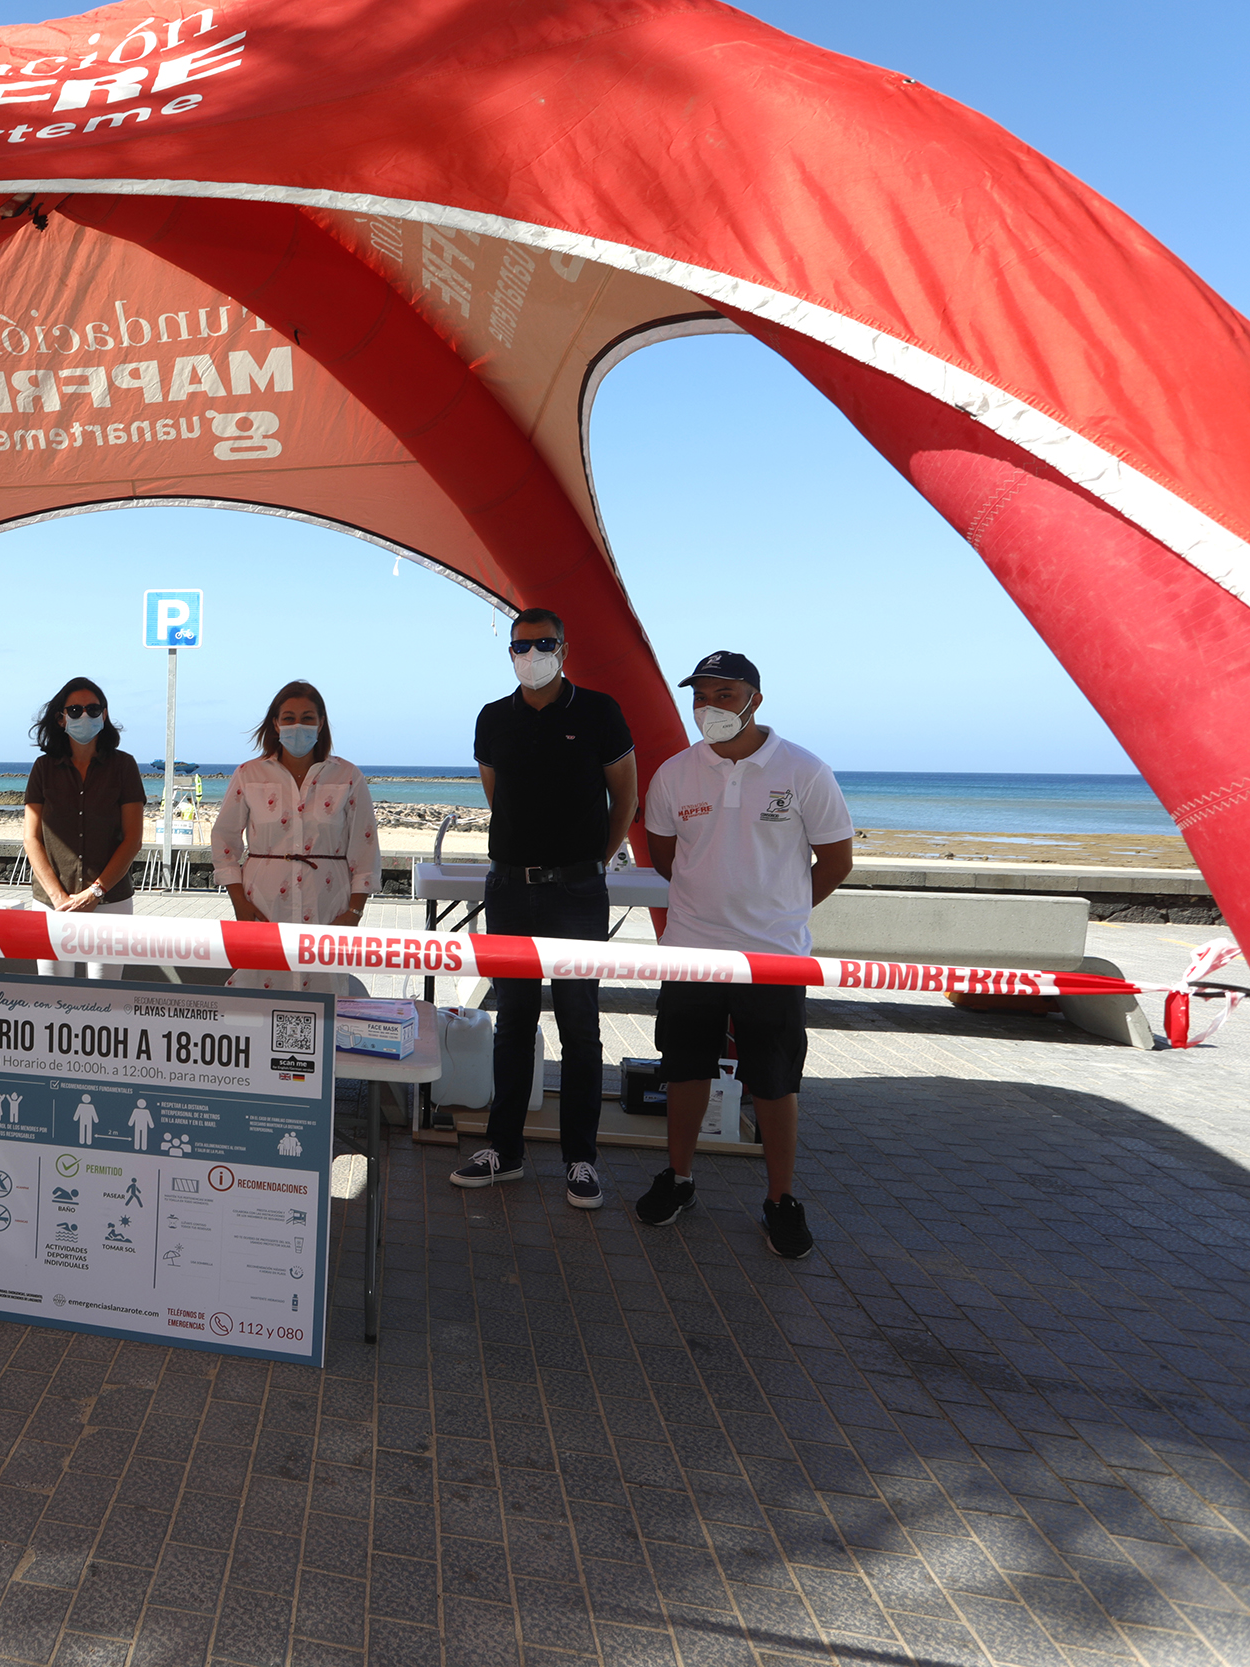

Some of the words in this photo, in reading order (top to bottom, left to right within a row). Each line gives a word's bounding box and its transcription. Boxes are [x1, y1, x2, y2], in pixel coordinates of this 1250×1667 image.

[157, 599, 190, 640] P
[678, 805, 713, 817] MAPFRE
[298, 933, 462, 972] BOMBEROS
[33, 1000, 51, 1009] con
[55, 999, 112, 1014] Seguridad
[134, 996, 185, 1007] RECOMENDACIONES
[186, 1000, 218, 1009] GENERALES
[134, 1005, 165, 1017] PLAYAS
[168, 1007, 218, 1021] LANZAROTE
[45, 1022, 128, 1060] 10:00H
[136, 1029, 151, 1061] A
[162, 1031, 250, 1068] 18:00H
[4, 1055, 46, 1069] Horario
[49, 1060, 63, 1071] de
[66, 1061, 109, 1076] 10:00h.
[122, 1065, 166, 1080] 12:00h.
[170, 1071, 196, 1083] para
[199, 1073, 250, 1087] mayores
[61, 1082, 98, 1091] RECOMENDACIONES
[86, 1164, 123, 1176] PERMITIDO
[237, 1179, 308, 1195] RECOMENDACIONES
[58, 1205, 75, 1213] BAÑO
[45, 1243, 88, 1254] ACTIVIDADES
[102, 1244, 124, 1252] TOMAR
[47, 1252, 87, 1262] DEPORTIVAS
[44, 1259, 89, 1270] INDIVIDUALES
[68, 1298, 159, 1318] emergenciaslanzarote.com
[167, 1307, 194, 1319] TELÉFONOS
[197, 1312, 205, 1320] DE
[168, 1318, 205, 1331] EMERGENCIAS
[238, 1321, 264, 1335] 112
[267, 1326, 274, 1339] y
[277, 1326, 304, 1341] 080
